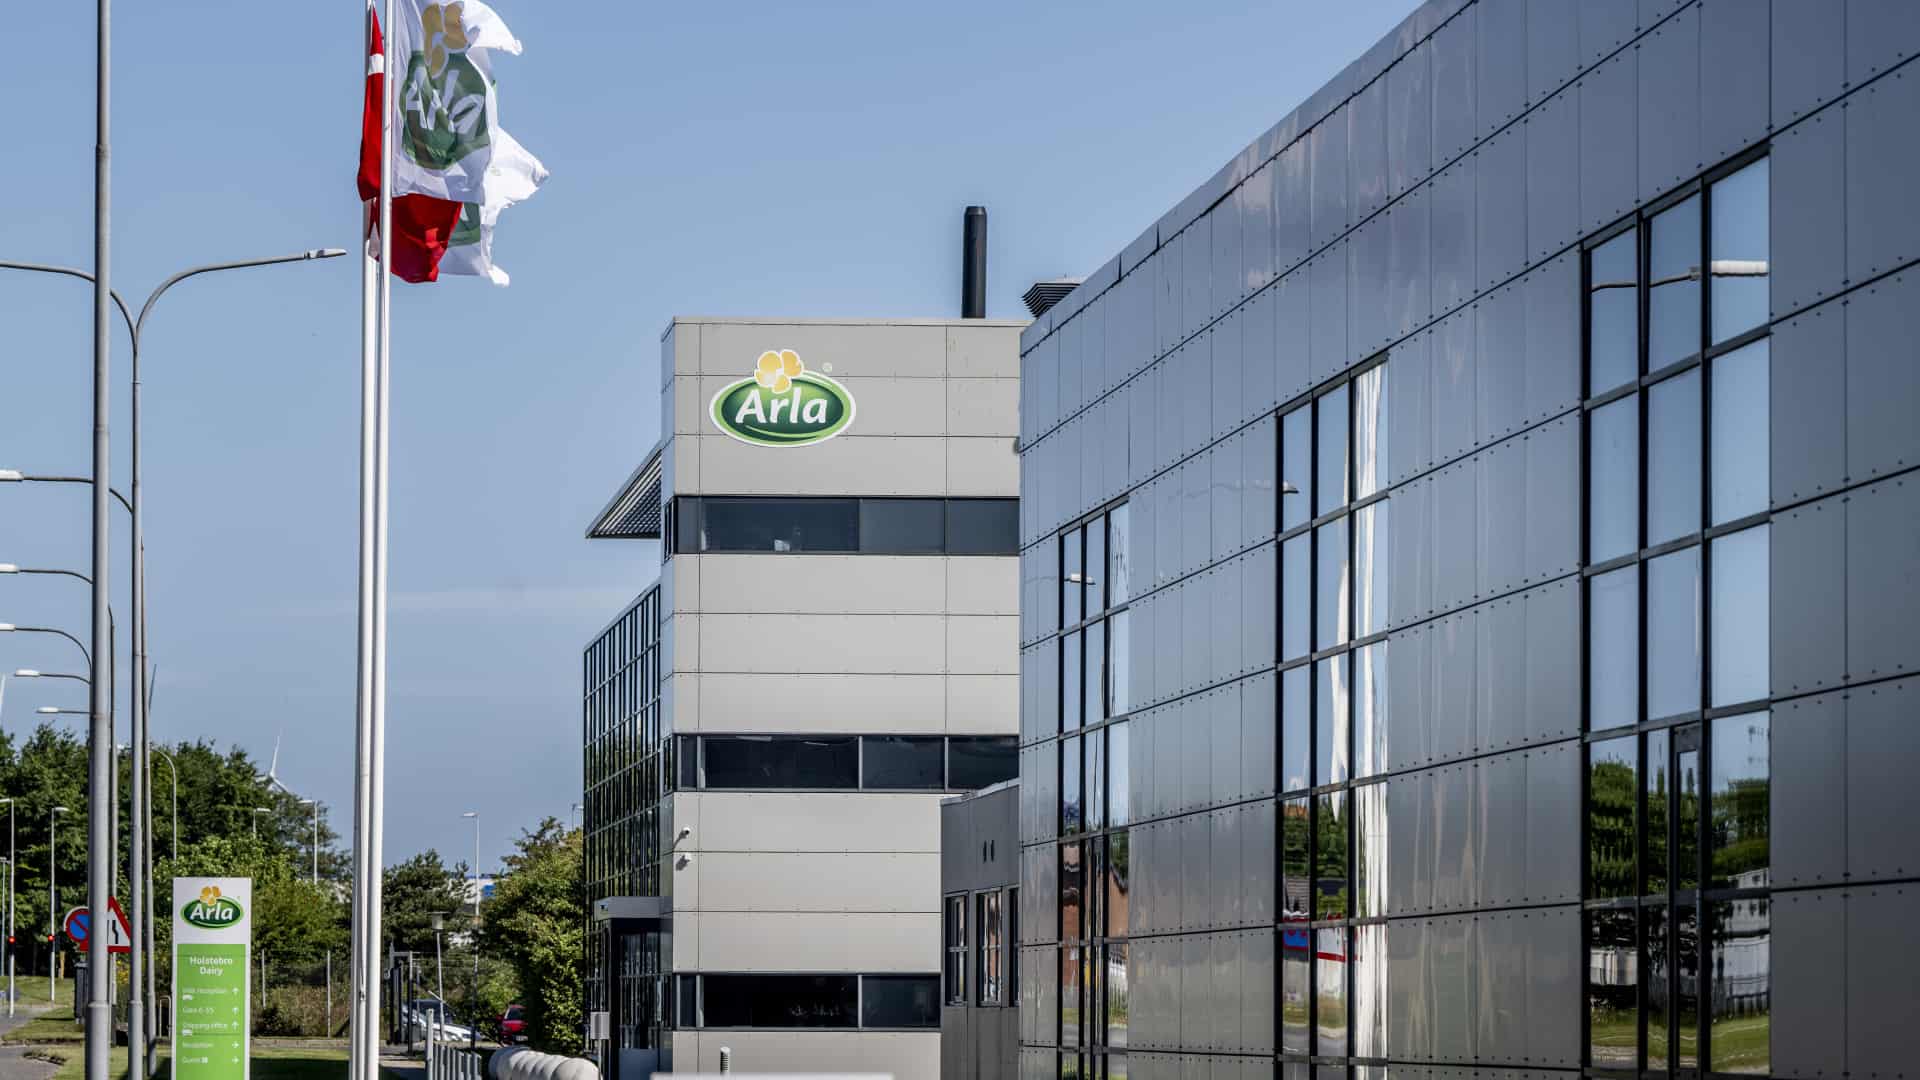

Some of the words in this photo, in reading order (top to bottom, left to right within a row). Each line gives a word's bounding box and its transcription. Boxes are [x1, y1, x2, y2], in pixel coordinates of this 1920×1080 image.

[735, 386, 827, 424] Arla
[190, 902, 234, 921] Arla
[189, 956, 233, 965] Holstebro
[200, 966, 224, 976] Dairy
